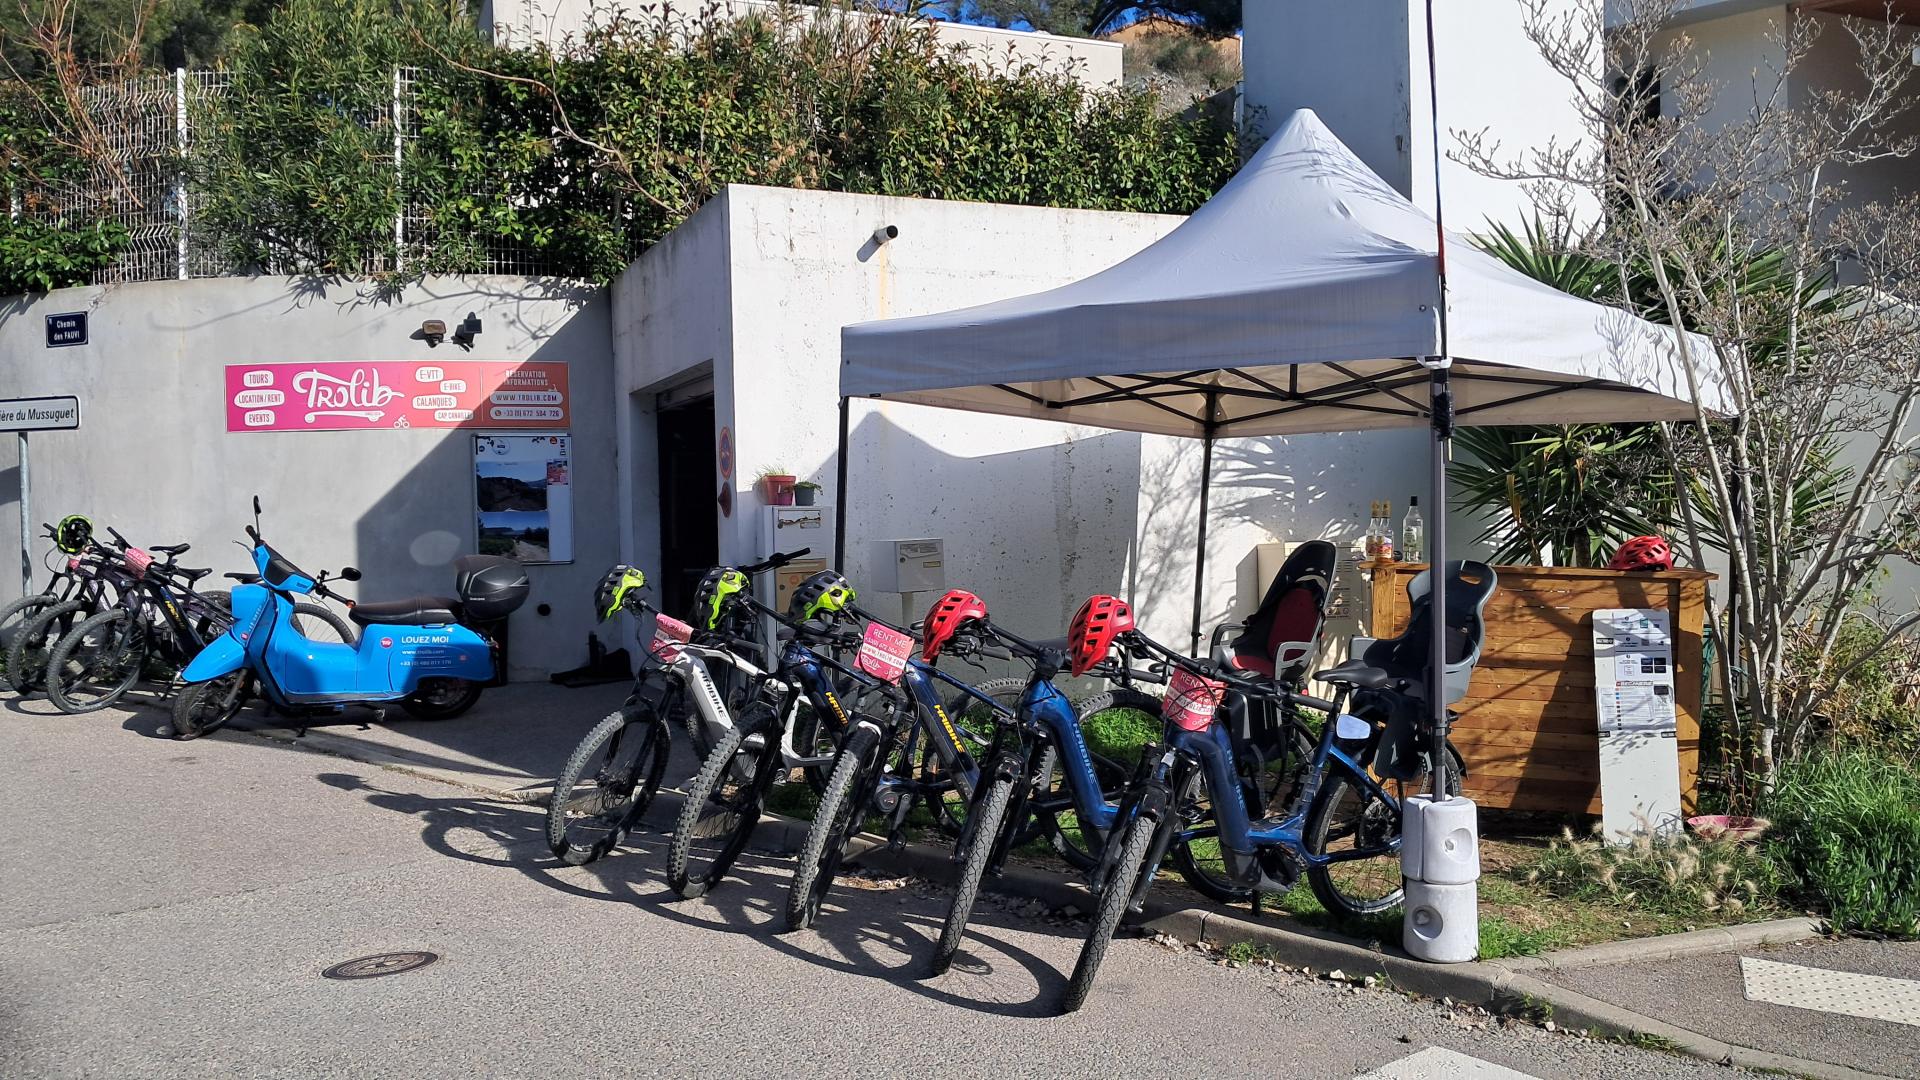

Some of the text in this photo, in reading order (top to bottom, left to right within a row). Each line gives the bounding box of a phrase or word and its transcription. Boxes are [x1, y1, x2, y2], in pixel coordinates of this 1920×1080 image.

[56, 320, 76, 329] Chemin
[64, 330, 80, 340] FAUVI
[248, 374, 269, 384] TOURS
[419, 369, 439, 379] E-VTT
[505, 370, 546, 378] RESERVATION
[443, 382, 462, 391] E-BIKE
[503, 378, 548, 386] INFORMATIONS
[416, 397, 453, 408] CALANQUES
[16, 409, 26, 421] du
[27, 407, 74, 422] Mussuguet
[248, 413, 270, 423] EVENTS
[437, 411, 447, 420] CAP
[401, 636, 430, 644] LOUEZ
[431, 635, 449, 644] MOI
[872, 628, 908, 649] RENT ME
[699, 670, 727, 719] HAIBIKE
[933, 704, 966, 754] HAIBIKE
[1072, 722, 1096, 785] HAIBIKE
